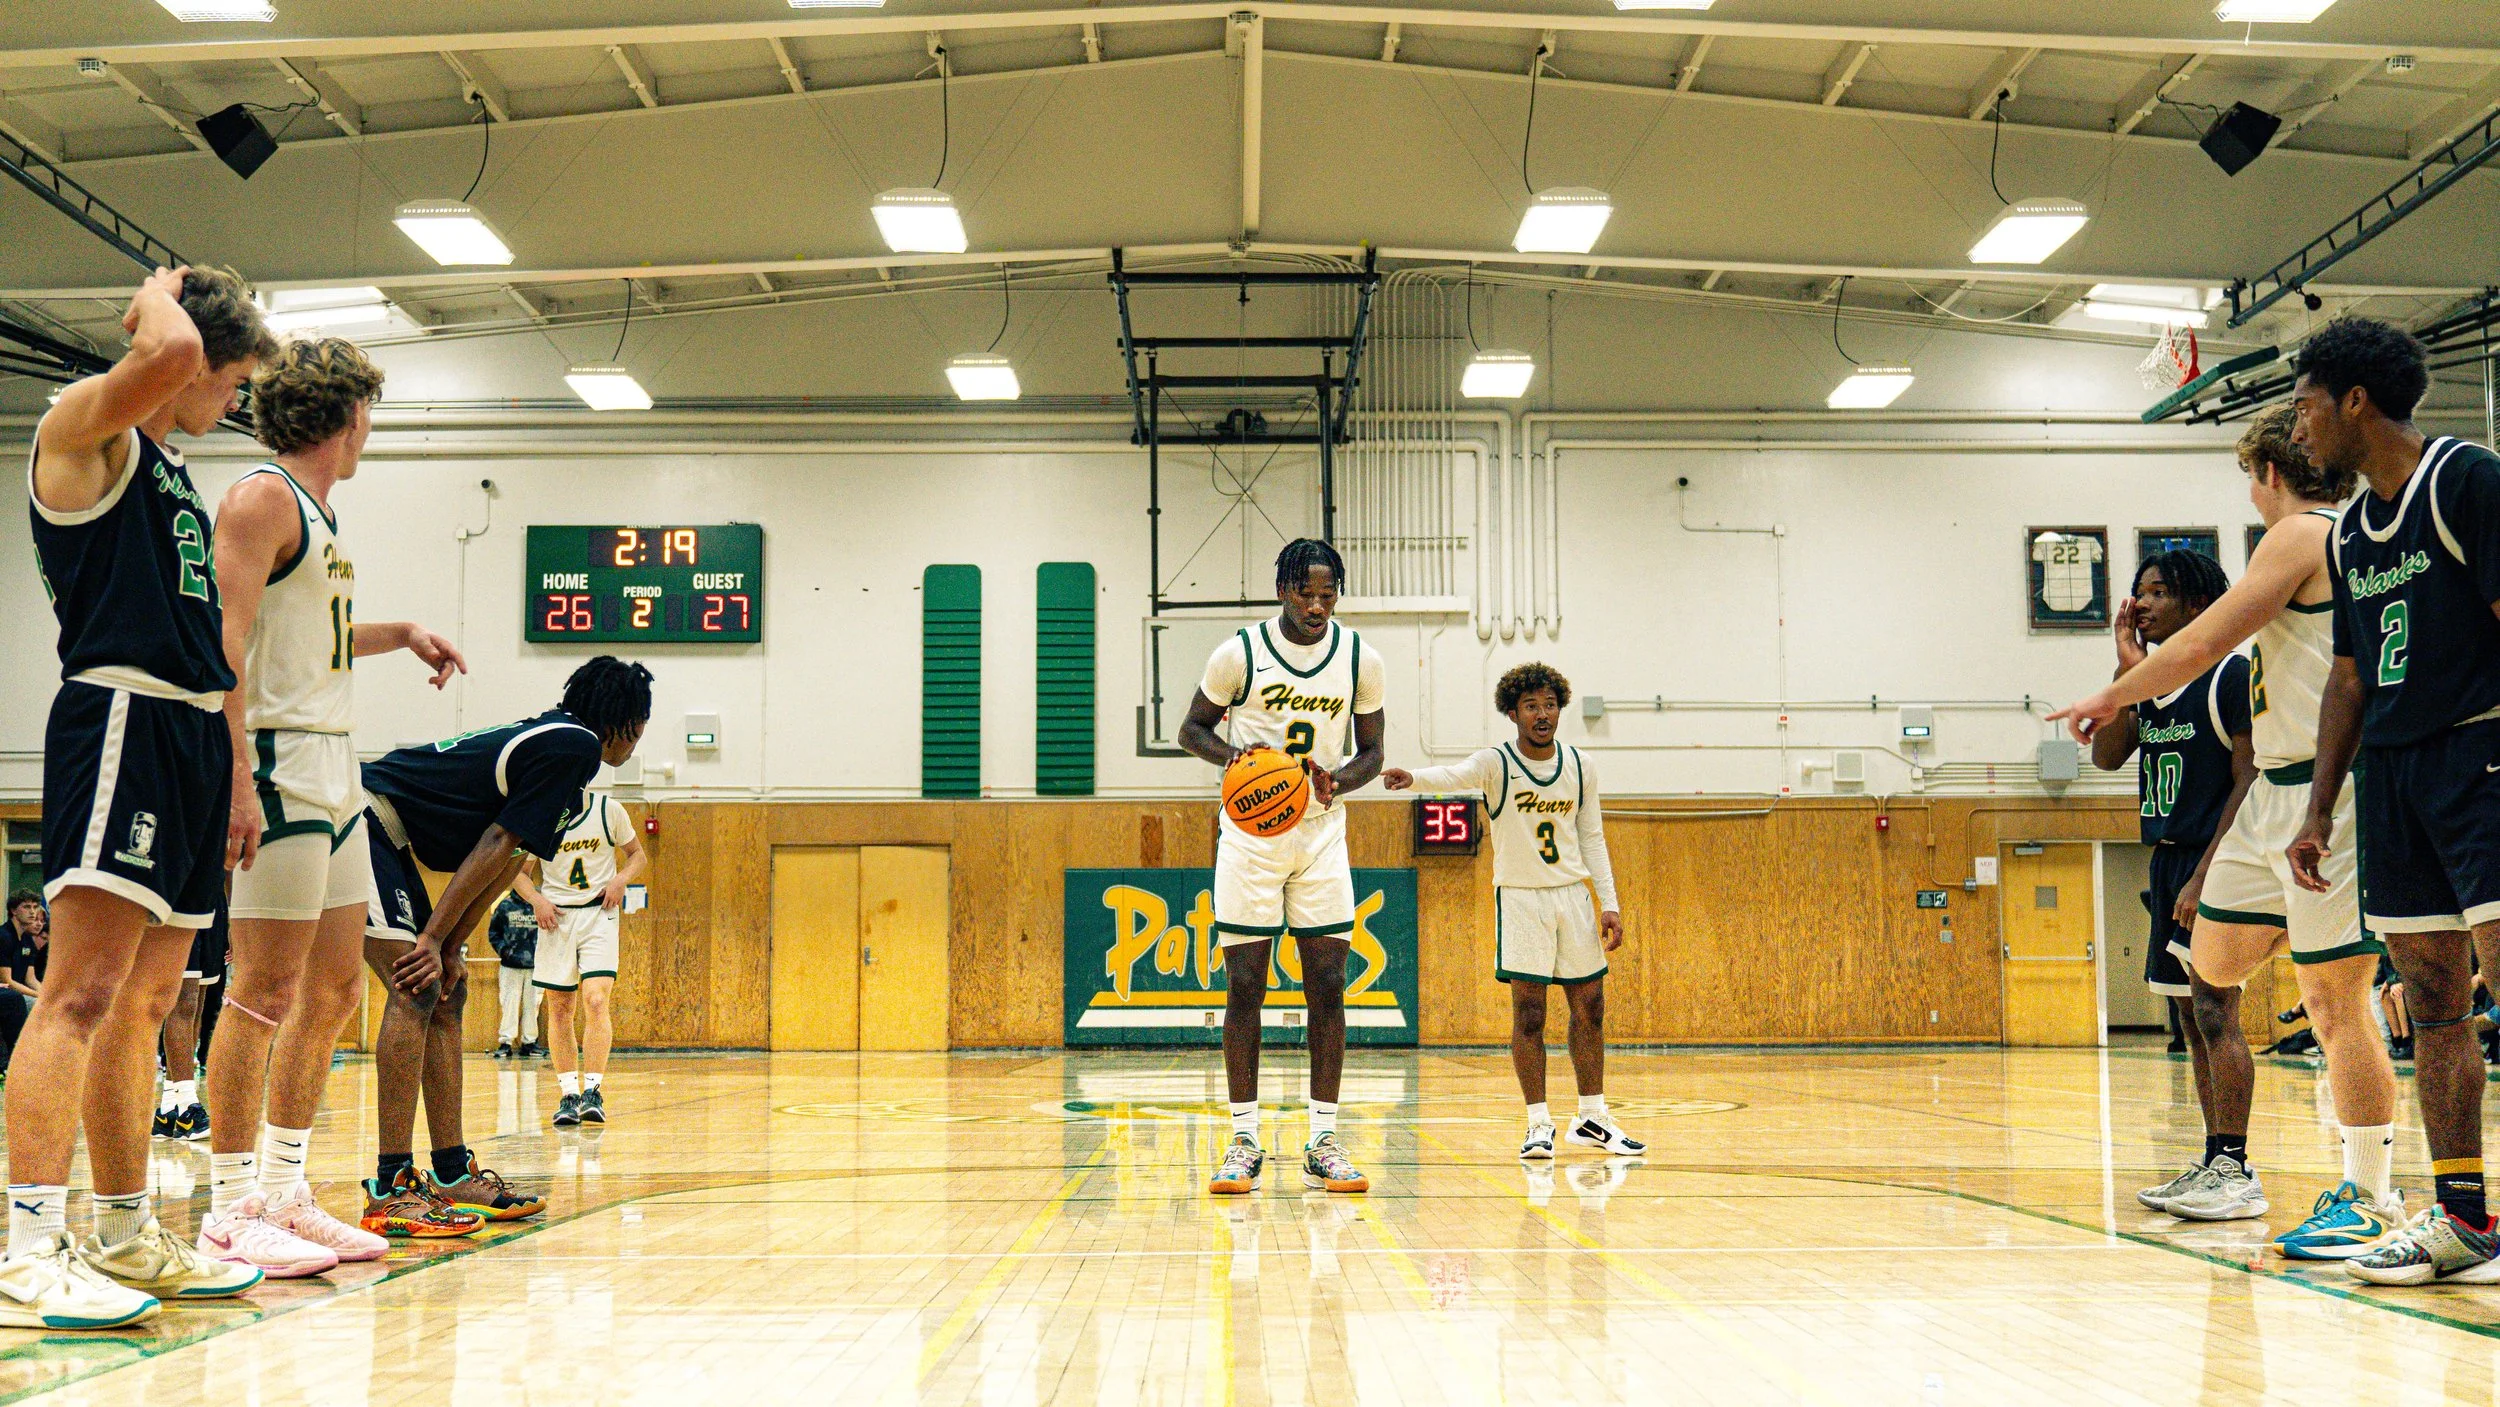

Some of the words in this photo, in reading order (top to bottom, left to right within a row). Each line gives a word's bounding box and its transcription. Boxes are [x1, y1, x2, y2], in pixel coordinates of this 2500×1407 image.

[615, 529, 696, 566] 2:19
[2053, 547, 2079, 564] 22
[543, 573, 589, 590] HOME
[623, 586, 662, 598] PERIOD
[693, 573, 744, 590] GUEST
[547, 596, 592, 630] 26
[632, 598, 653, 628] 2
[703, 596, 749, 630] 27
[2378, 599, 2409, 687] 2
[1260, 683, 1345, 720] Henry
[1285, 719, 1317, 776] 2
[1233, 778, 1290, 814] Wilson
[2140, 751, 2184, 817] 10
[1256, 805, 1295, 832] NCAA
[1514, 791, 1574, 817] Henry
[1424, 803, 1469, 842] 35
[558, 838, 601, 853] enry
[1536, 819, 1560, 865] 3
[568, 856, 591, 891] 4
[1103, 885, 1387, 1001] Pats
